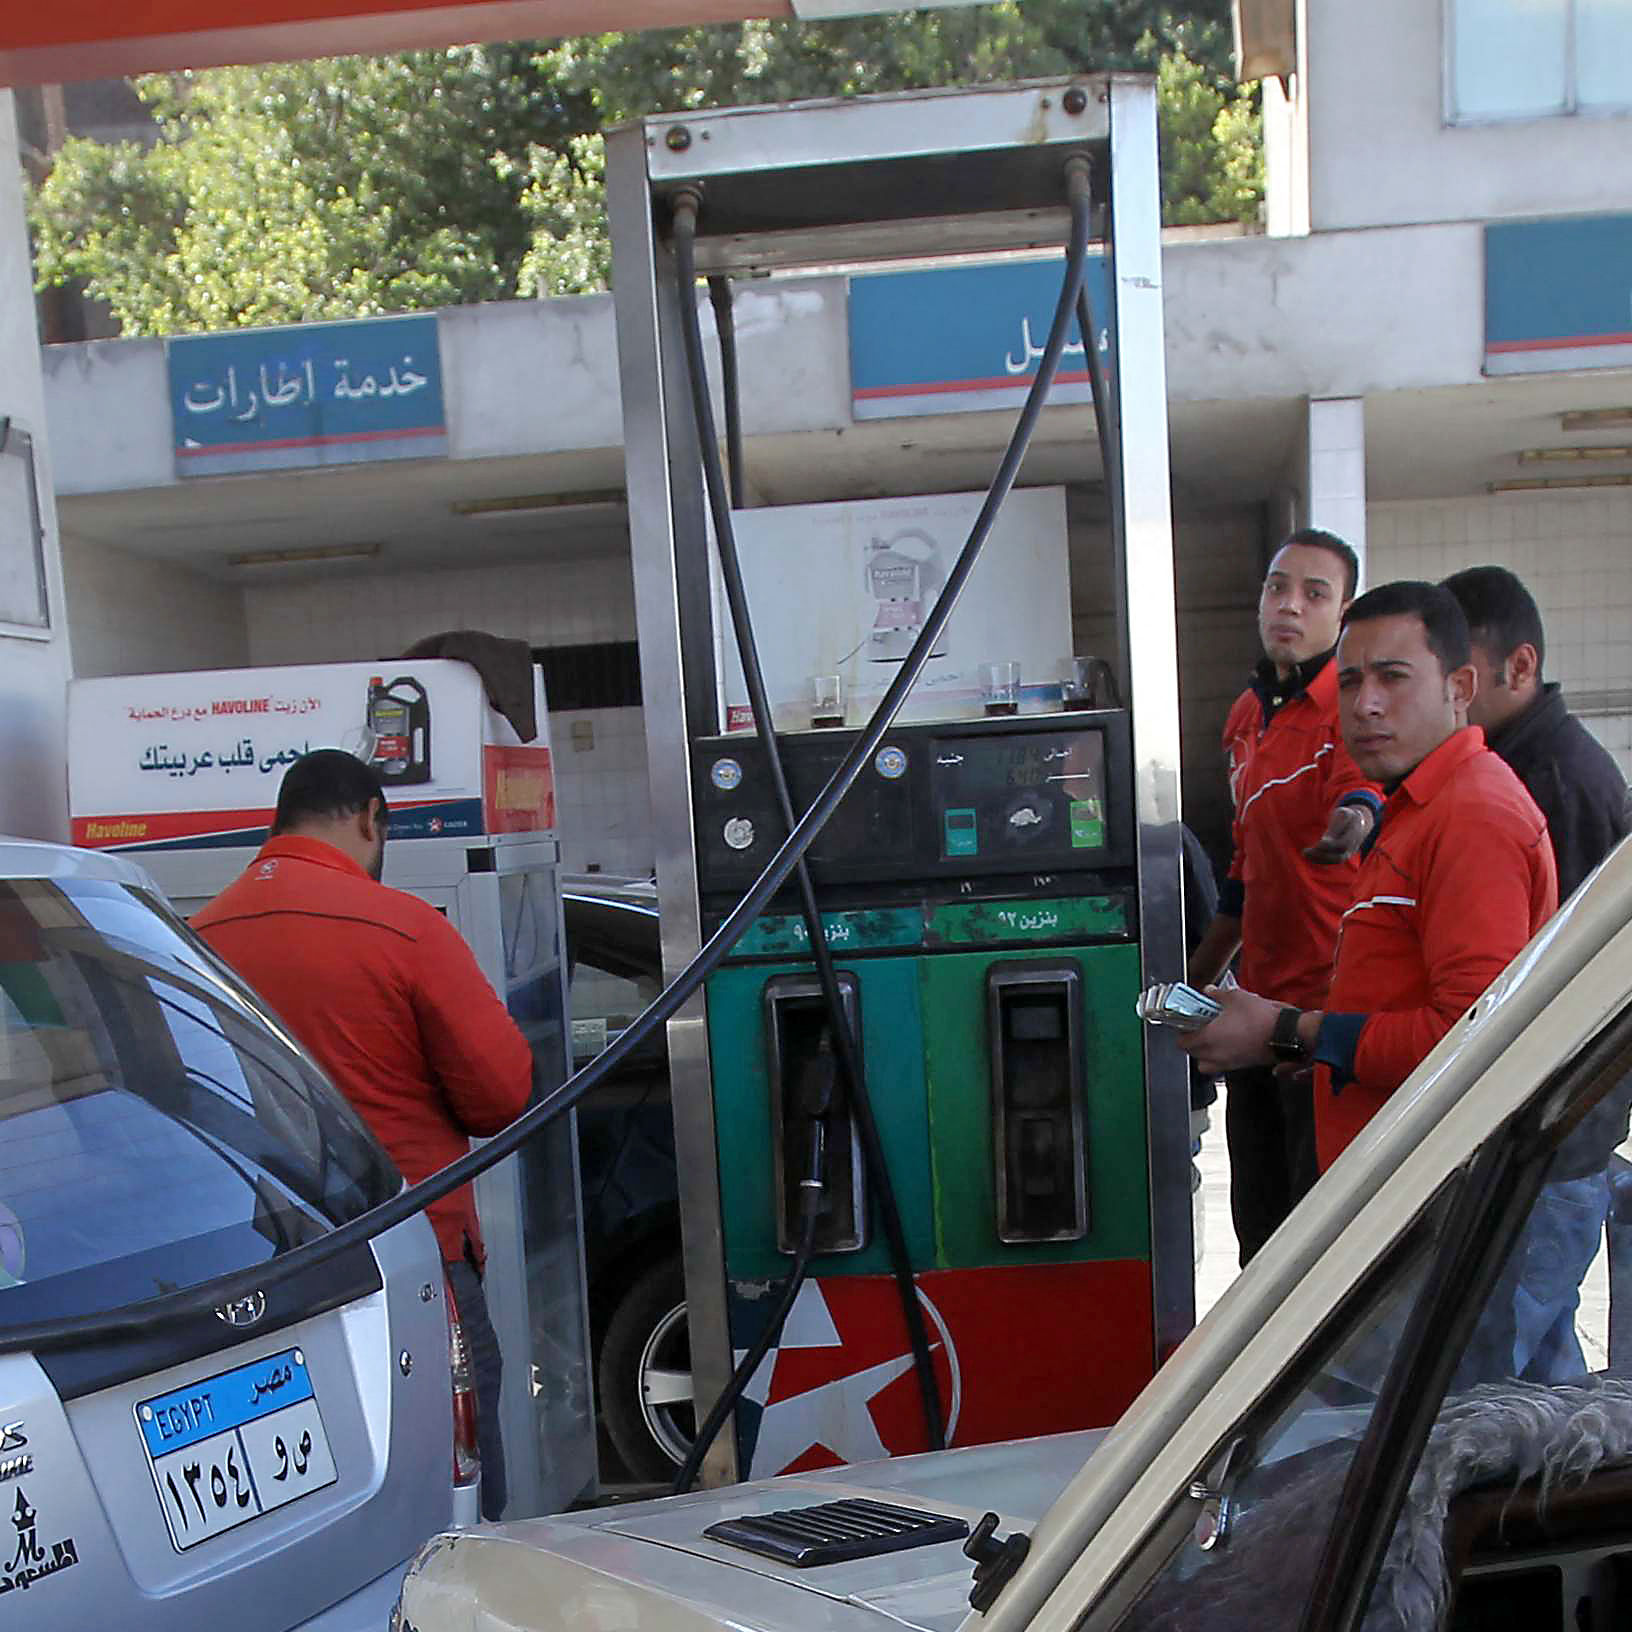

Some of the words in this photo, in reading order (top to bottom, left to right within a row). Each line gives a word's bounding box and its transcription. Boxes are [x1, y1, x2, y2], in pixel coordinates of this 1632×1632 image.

[333, 356, 427, 399] خدمة
[212, 698, 270, 715] HAVOLINE
[139, 744, 213, 776] عربيتك
[219, 739, 254, 774] قلب
[248, 1365, 293, 1405] مصر
[155, 1393, 215, 1440] EGYPT
[165, 1446, 251, 1532] ١٣٥٤
